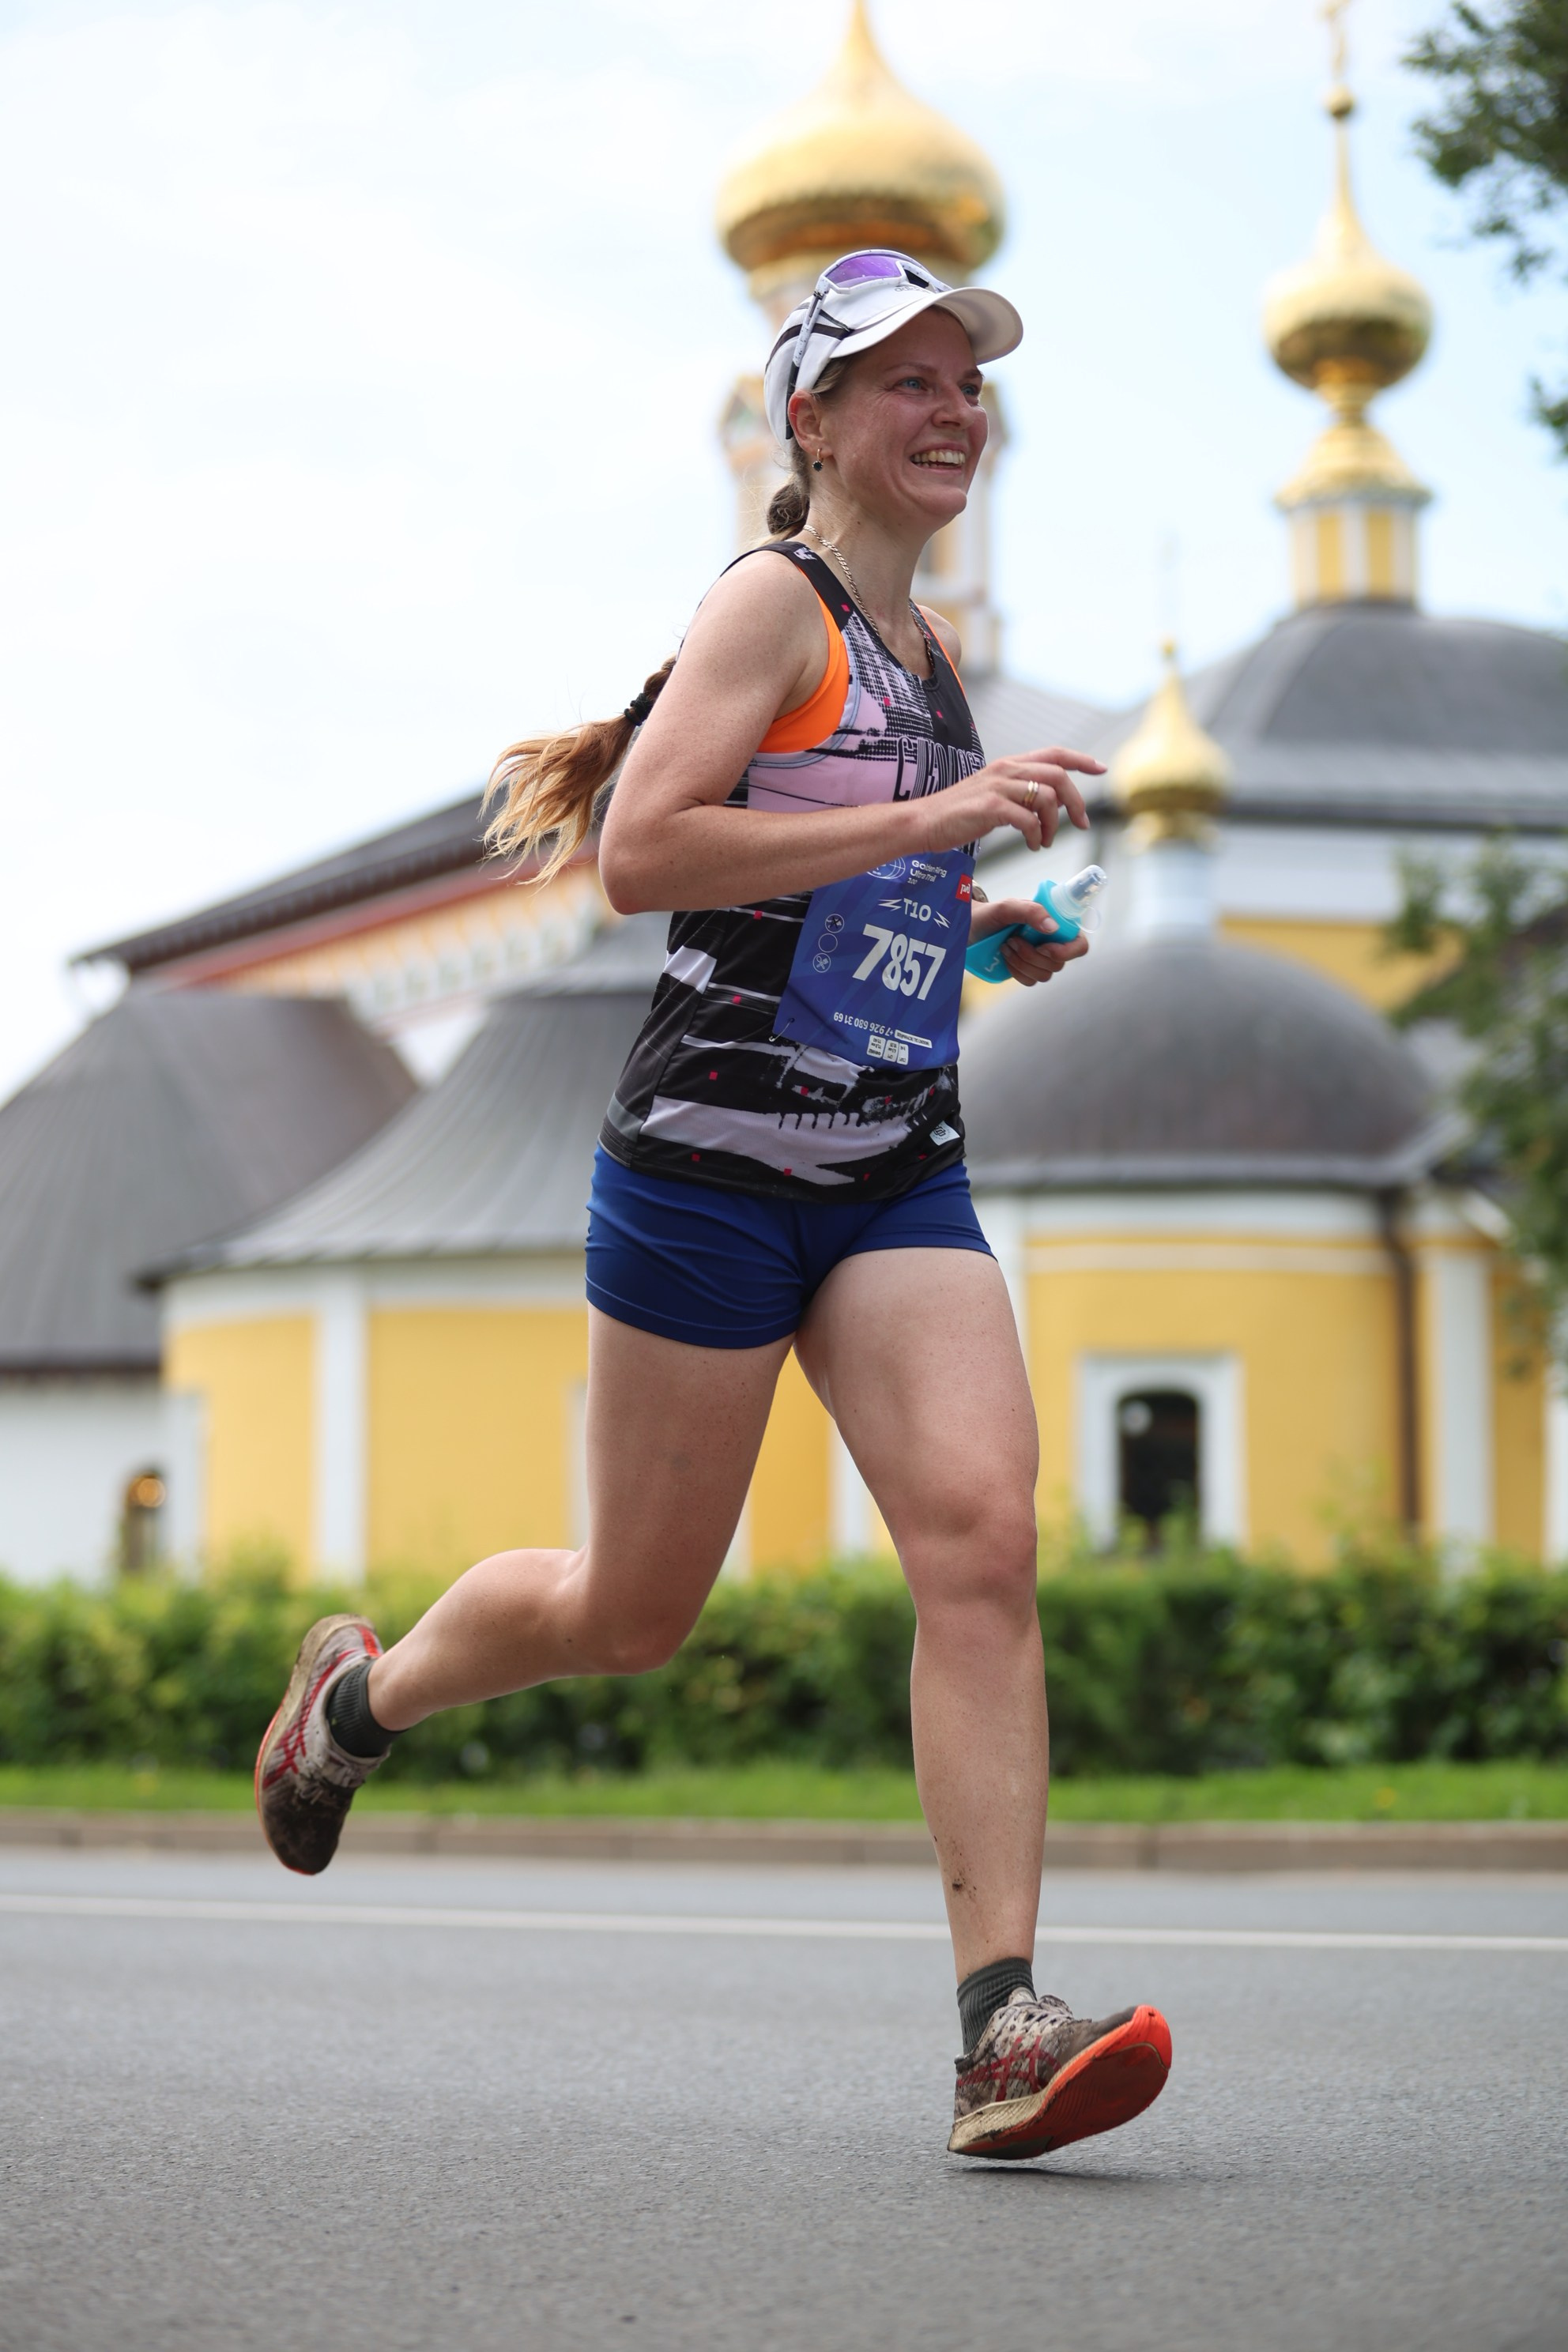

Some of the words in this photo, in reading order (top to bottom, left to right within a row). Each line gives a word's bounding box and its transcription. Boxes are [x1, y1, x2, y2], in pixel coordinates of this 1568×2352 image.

[910, 869, 925, 879] Ultra
[925, 873, 937, 882] Trail
[935, 865, 948, 878] Ring
[903, 898, 932, 922] T10
[852, 923, 947, 1001] 7857
[833, 1012, 844, 1023] 69
[844, 1015, 854, 1026] 31
[854, 1018, 869, 1030] 680
[869, 1023, 886, 1035] 926
[885, 1027, 894, 1037] +7
